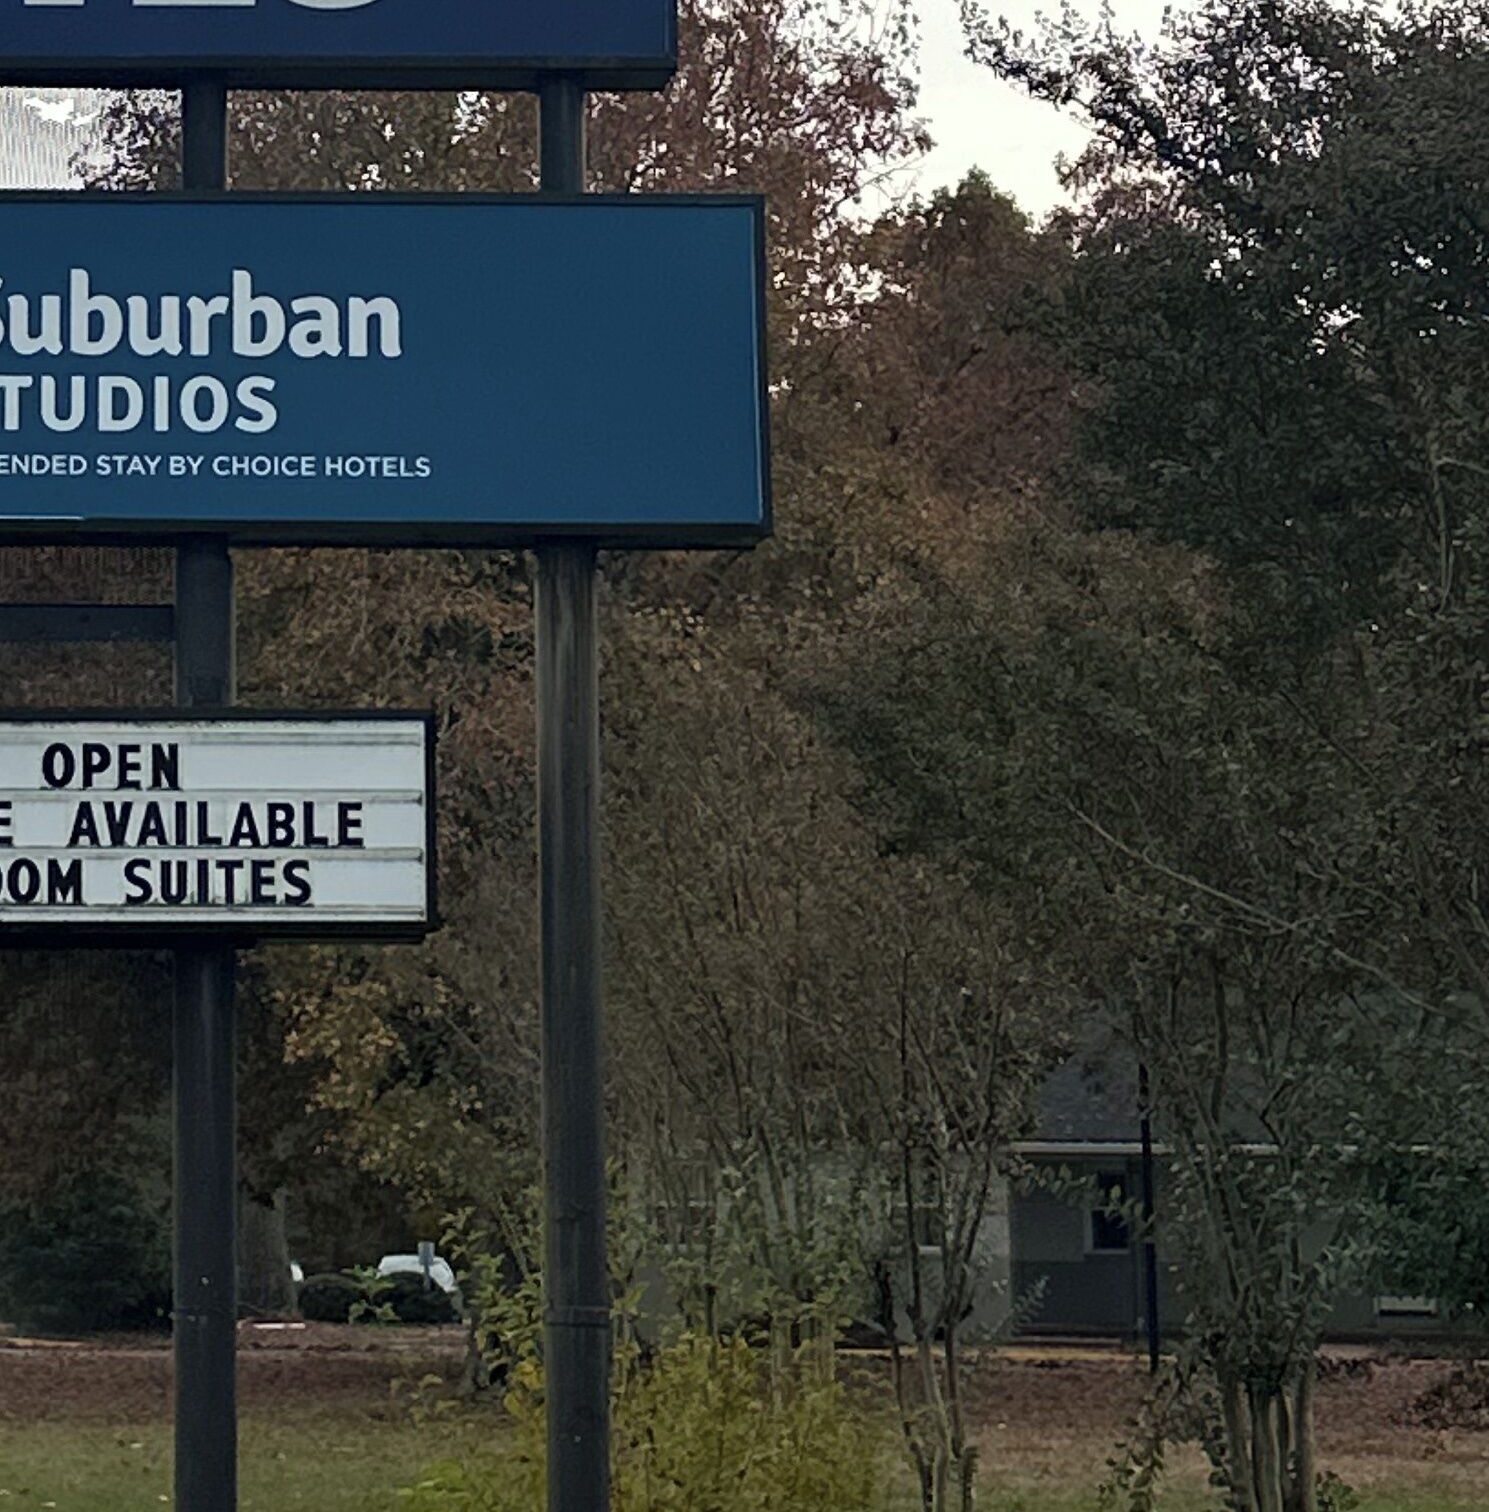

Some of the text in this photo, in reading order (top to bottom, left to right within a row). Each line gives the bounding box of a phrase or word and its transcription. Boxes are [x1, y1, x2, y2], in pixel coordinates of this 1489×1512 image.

[96, 454, 161, 476] STAY
[169, 455, 205, 476] BY
[212, 455, 317, 477] CHOICE
[325, 456, 431, 478] HOTELS
[41, 742, 180, 789] OPEN
[68, 801, 364, 848] AVAILABLE
[123, 859, 312, 906] SUITES
